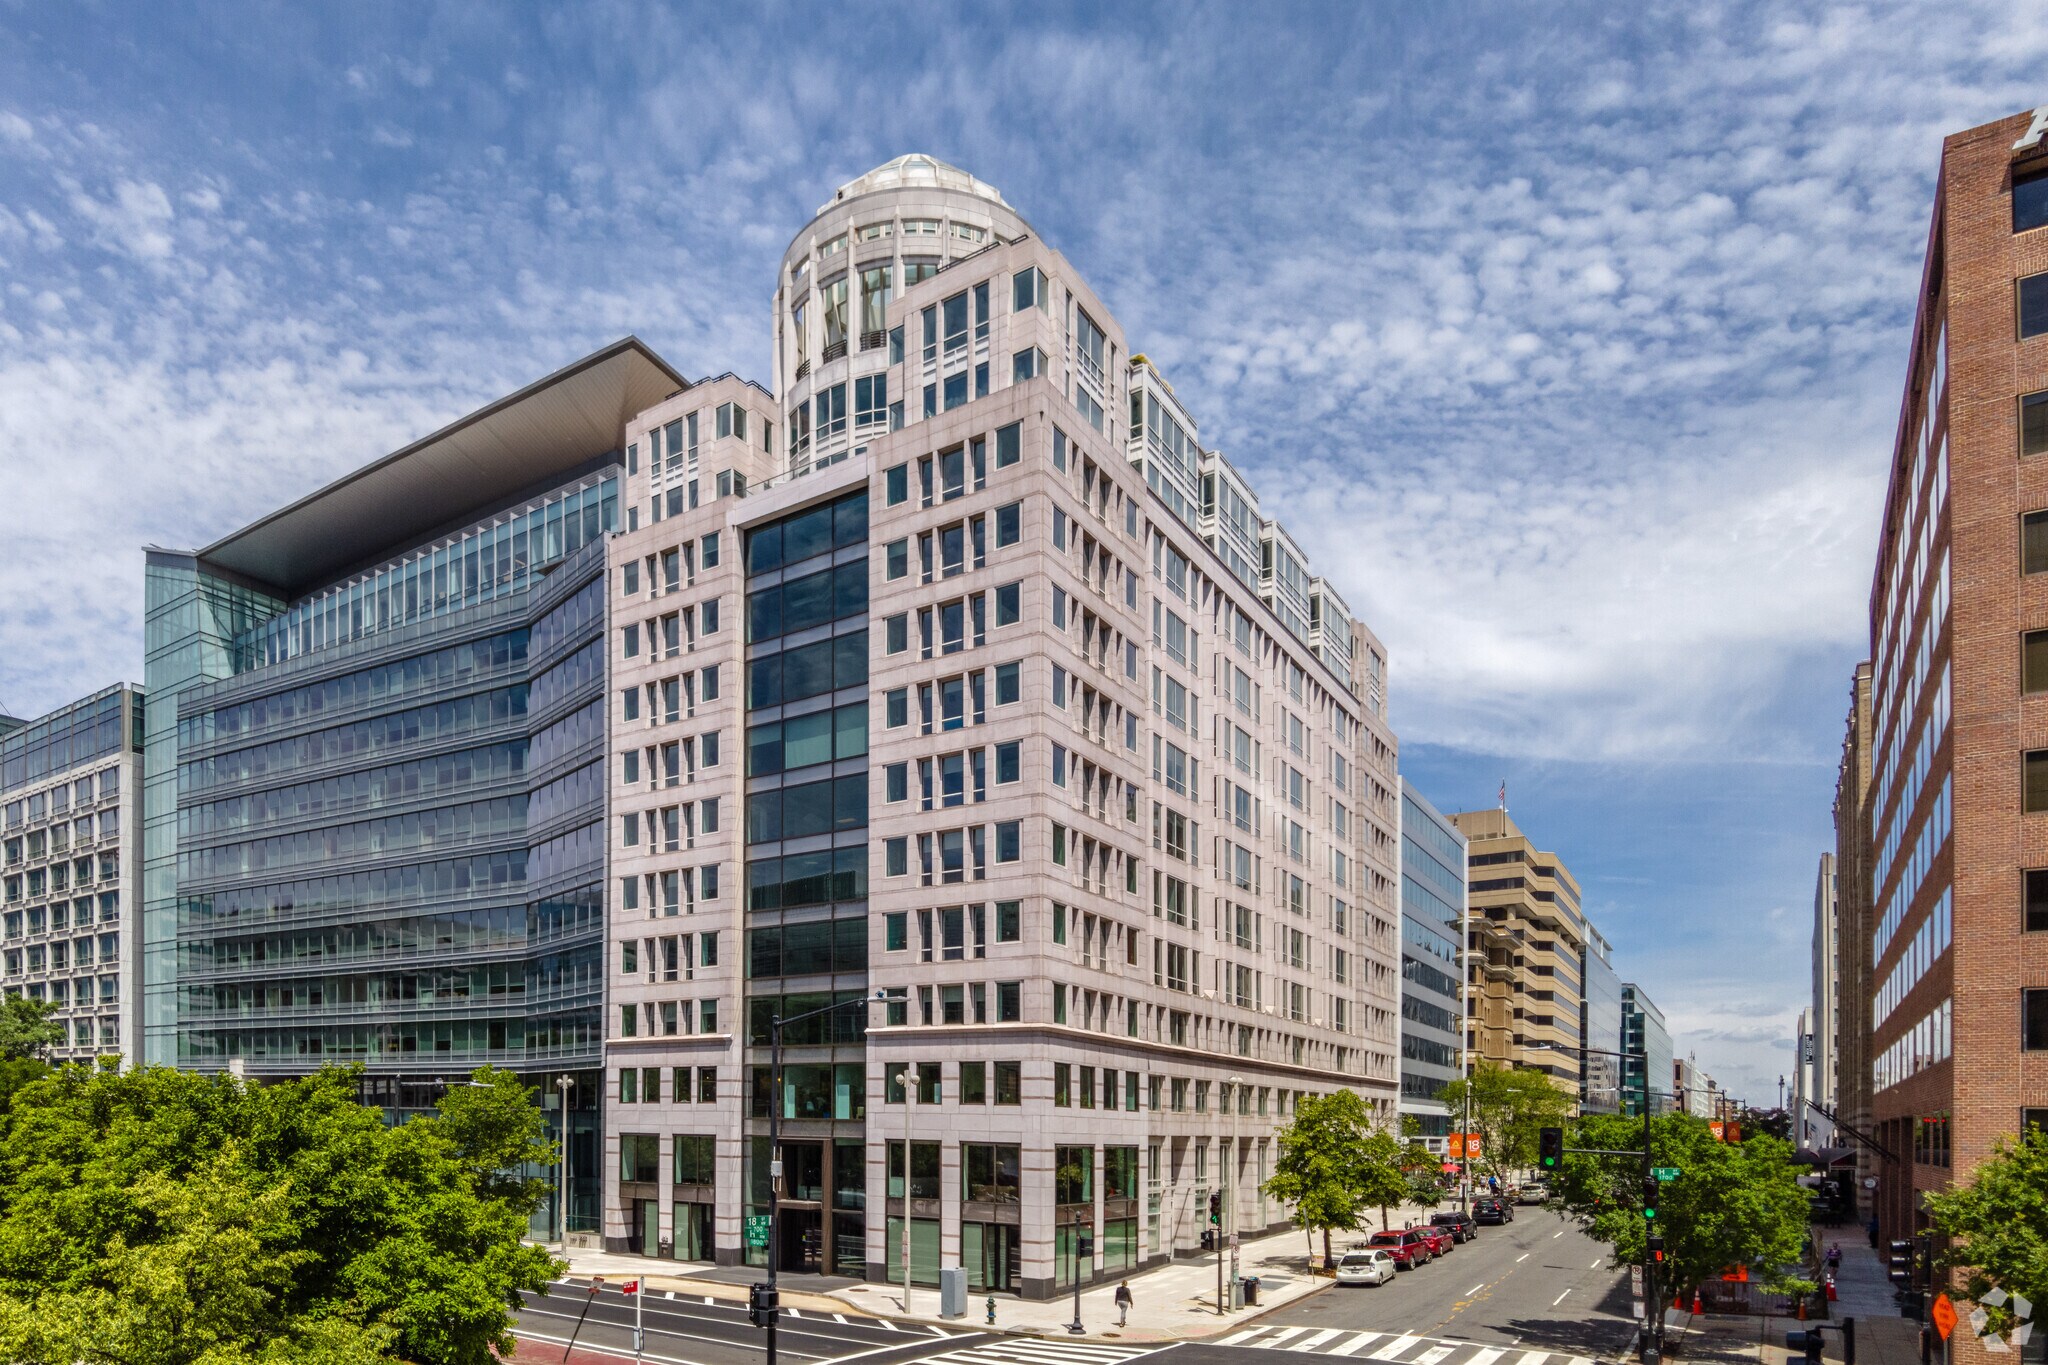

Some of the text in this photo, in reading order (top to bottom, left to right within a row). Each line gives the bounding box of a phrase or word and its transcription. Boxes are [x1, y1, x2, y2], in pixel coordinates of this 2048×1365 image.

[1711, 1127, 1723, 1136] 18
[1468, 1140, 1479, 1150] 18
[748, 1217, 757, 1226] 18
[1656, 1250, 1662, 1261] 8
